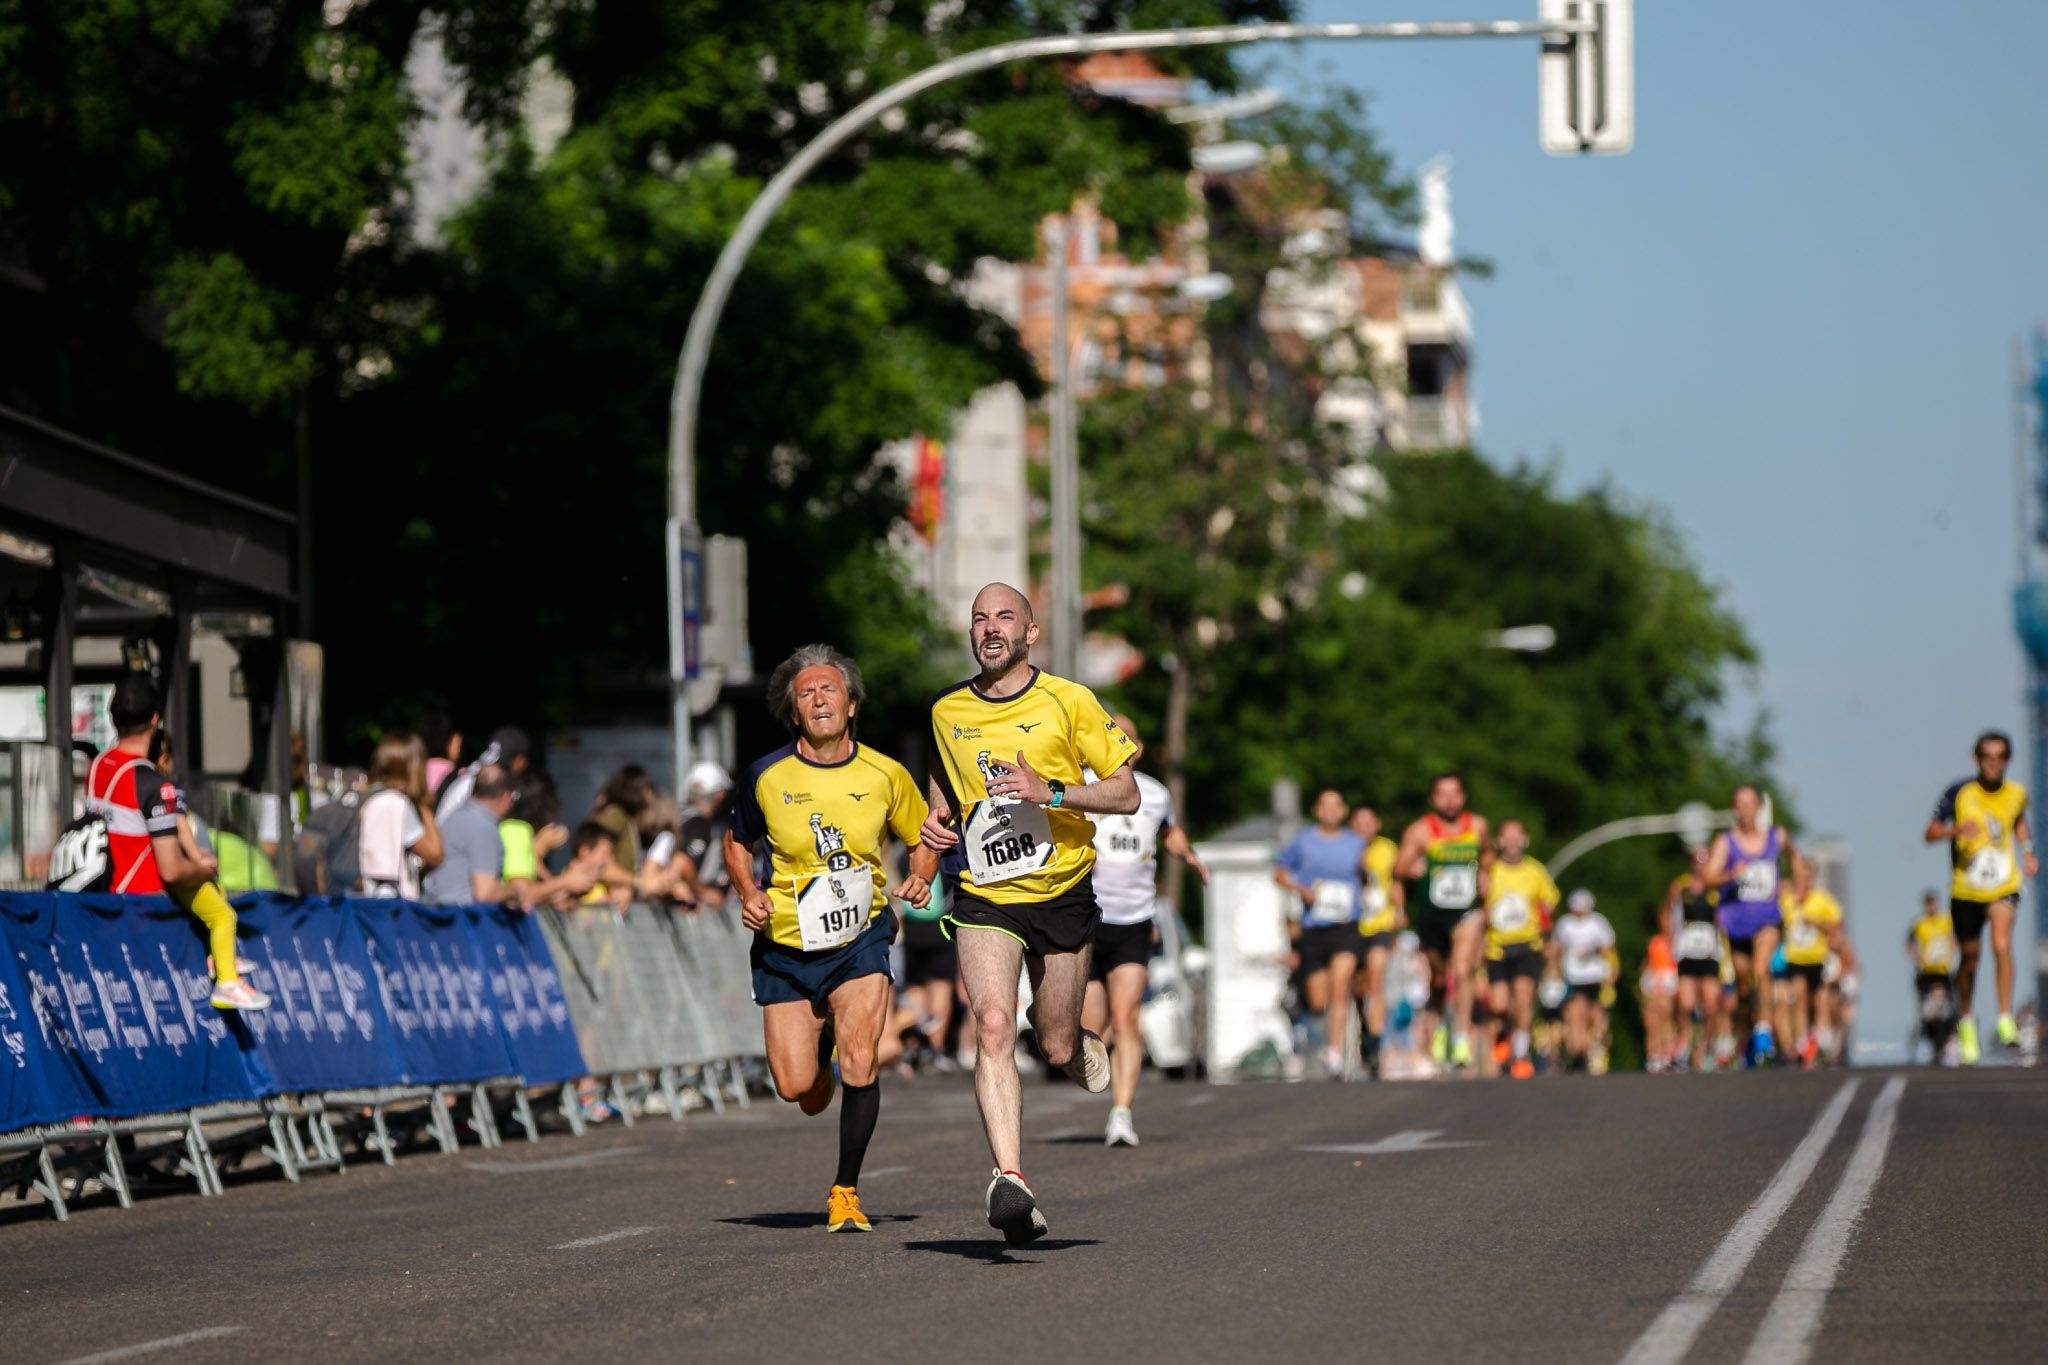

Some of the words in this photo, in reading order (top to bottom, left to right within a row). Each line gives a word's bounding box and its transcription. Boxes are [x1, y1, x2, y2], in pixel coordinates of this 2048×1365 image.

[831, 855, 848, 870] 13
[981, 833, 1037, 867] 1688
[819, 904, 859, 934] 1971
